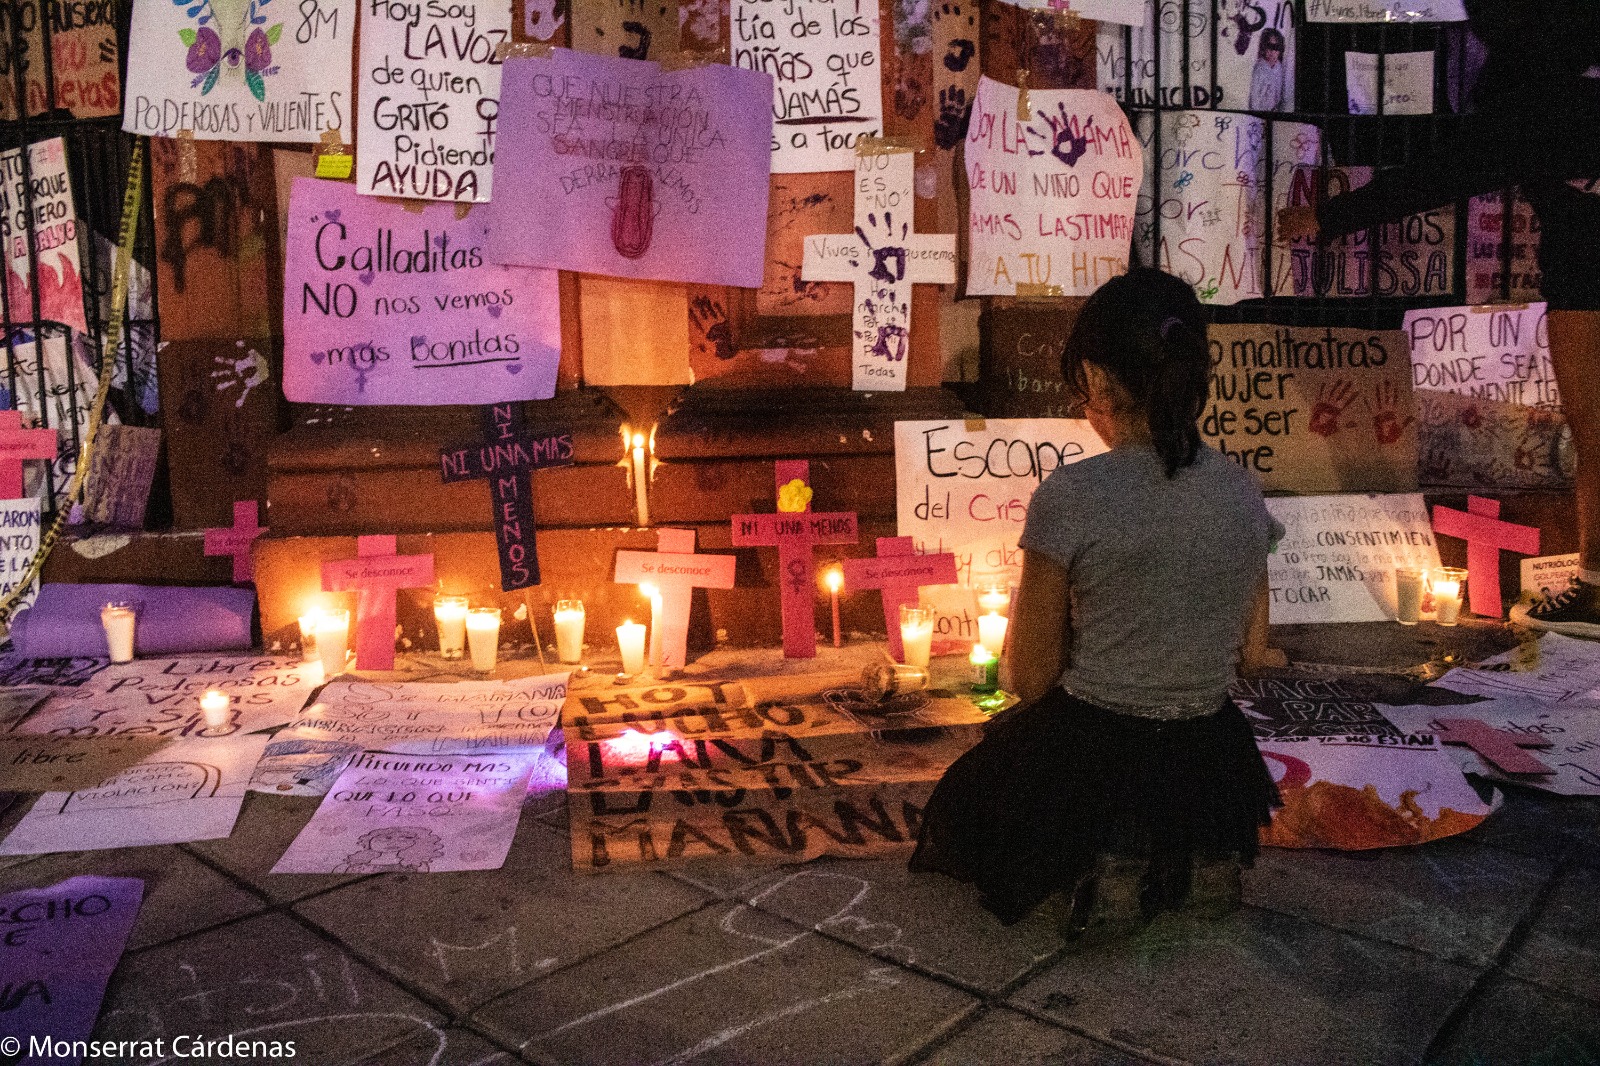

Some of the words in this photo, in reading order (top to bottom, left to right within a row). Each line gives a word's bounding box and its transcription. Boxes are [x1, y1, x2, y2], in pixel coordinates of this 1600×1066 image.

[734, 6, 775, 42] tía
[790, 7, 822, 38] de
[833, 8, 870, 38] las
[404, 22, 447, 60] LA
[452, 27, 509, 65] VOZ
[371, 55, 404, 84] de
[411, 68, 482, 101] quien
[736, 46, 813, 83] niñas
[827, 51, 874, 86] que
[532, 73, 585, 99] QUE
[590, 79, 704, 107] NUESTRA
[773, 82, 861, 119] JAMÁS
[135, 95, 240, 132] PODEROSAS
[258, 91, 342, 131] VALIENTES
[536, 110, 585, 136] SEA
[791, 132, 808, 149] a
[1002, 110, 1030, 155] LA
[652, 143, 703, 165] QUE
[859, 153, 890, 171] NO
[15, 171, 69, 208] PRQUE
[371, 161, 478, 200] AYUDA
[859, 176, 887, 193] ES
[992, 171, 1017, 195] UN
[1033, 171, 1080, 199] NIÑO
[1092, 171, 1133, 200] QUE
[15, 200, 67, 231] QIERO
[812, 237, 860, 259] Vivas
[994, 256, 1012, 286] A
[1019, 253, 1052, 284] TU
[302, 282, 358, 318] NO
[374, 295, 421, 316] nos
[434, 288, 513, 313] vemos
[327, 340, 391, 366] más
[411, 329, 520, 362] bonitas
[1411, 313, 1468, 352] POR
[1489, 312, 1522, 348] UN
[1231, 328, 1388, 369] maltratas
[858, 364, 896, 378] Todas
[1413, 355, 1486, 387] DONDE
[1203, 404, 1237, 437] de
[1244, 407, 1298, 436] ser
[440, 450, 470, 478] NI
[480, 442, 531, 473] UNA
[921, 426, 1084, 483] Escape
[915, 484, 950, 521] del
[968, 493, 1033, 522] Cris
[740, 519, 760, 537] NI
[810, 518, 853, 537] MENOS
[1316, 530, 1432, 548] CONSENTIMIEN
[345, 568, 359, 580] Se
[360, 566, 415, 579] desconoce
[641, 561, 656, 575] Se
[657, 561, 713, 577] desconoce
[1281, 551, 1300, 565] TO
[1269, 585, 1331, 604] TOCAR
[162, 660, 300, 675] Libres
[106, 674, 302, 693] Poderosas
[146, 692, 274, 706] Vias
[12, 750, 88, 766] libre
[462, 761, 513, 773] MAS
[333, 791, 375, 803] QUE
[427, 791, 480, 803] QUE
